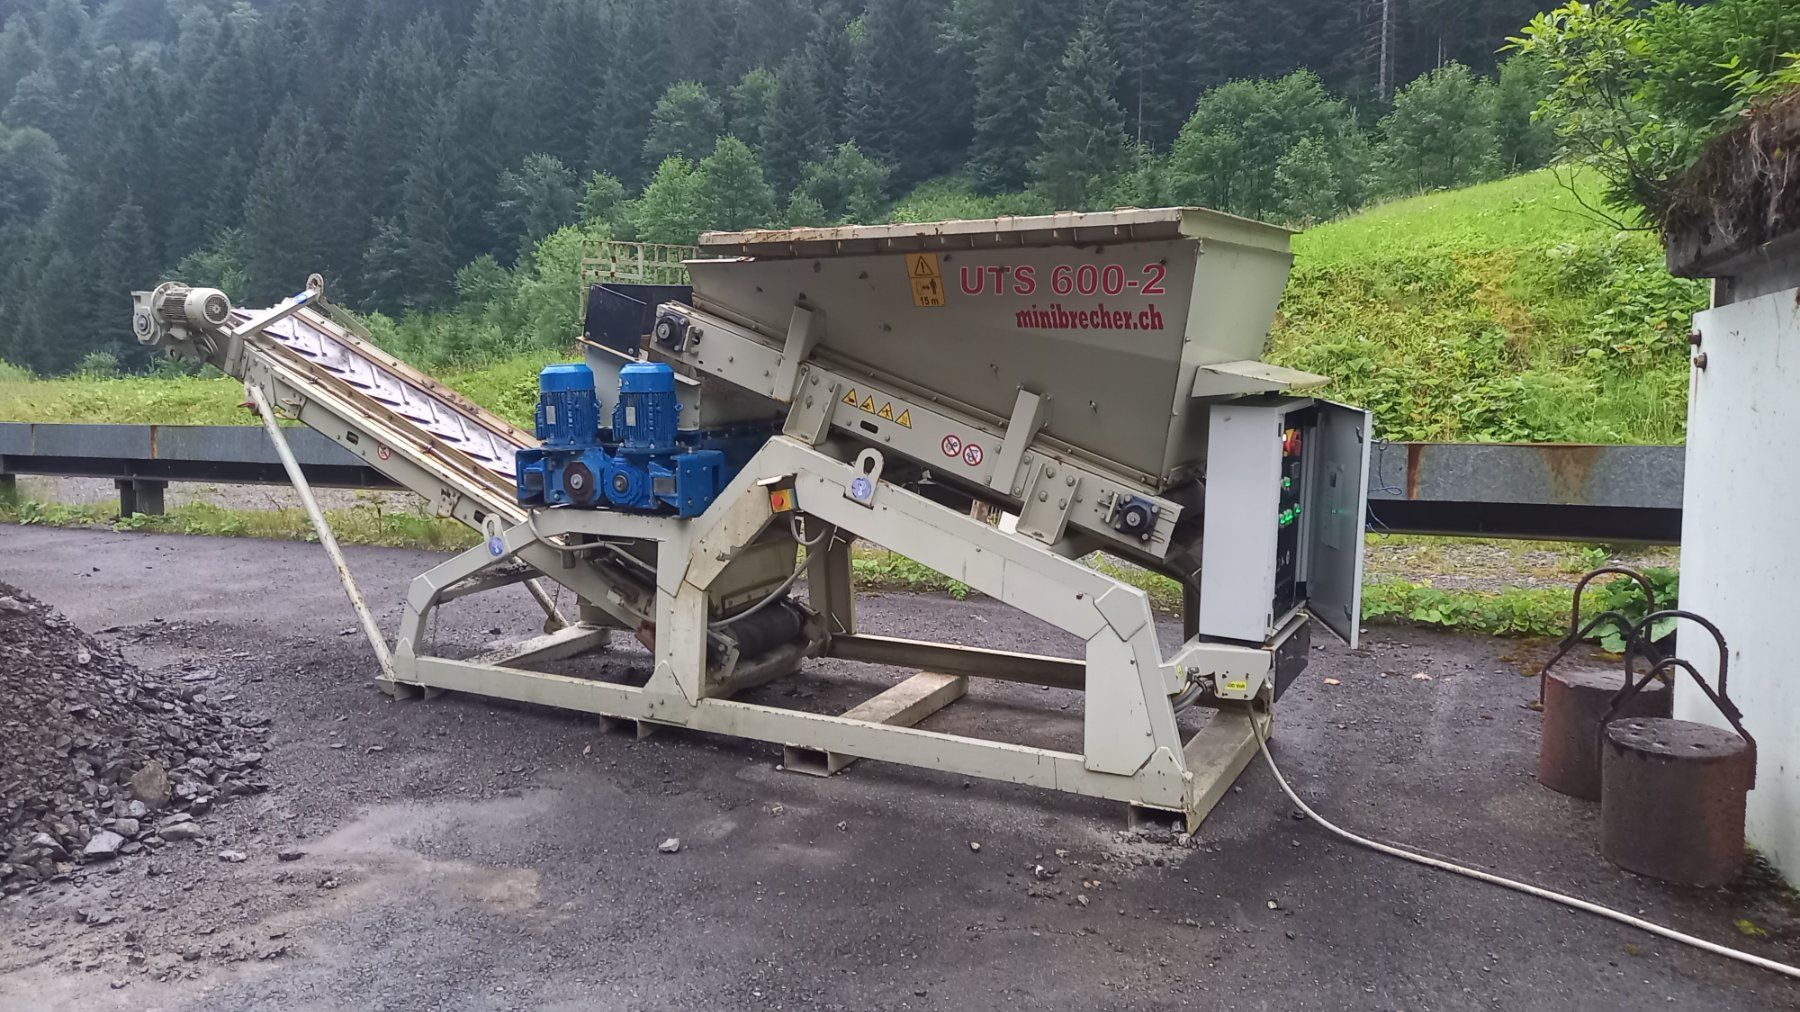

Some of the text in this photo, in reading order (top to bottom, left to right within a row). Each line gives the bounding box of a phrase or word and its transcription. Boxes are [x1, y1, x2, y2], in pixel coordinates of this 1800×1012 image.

[960, 263, 1166, 295] UTS 600-2
[920, 296, 930, 305] 15
[1015, 303, 1164, 330] minibrecher.ch
